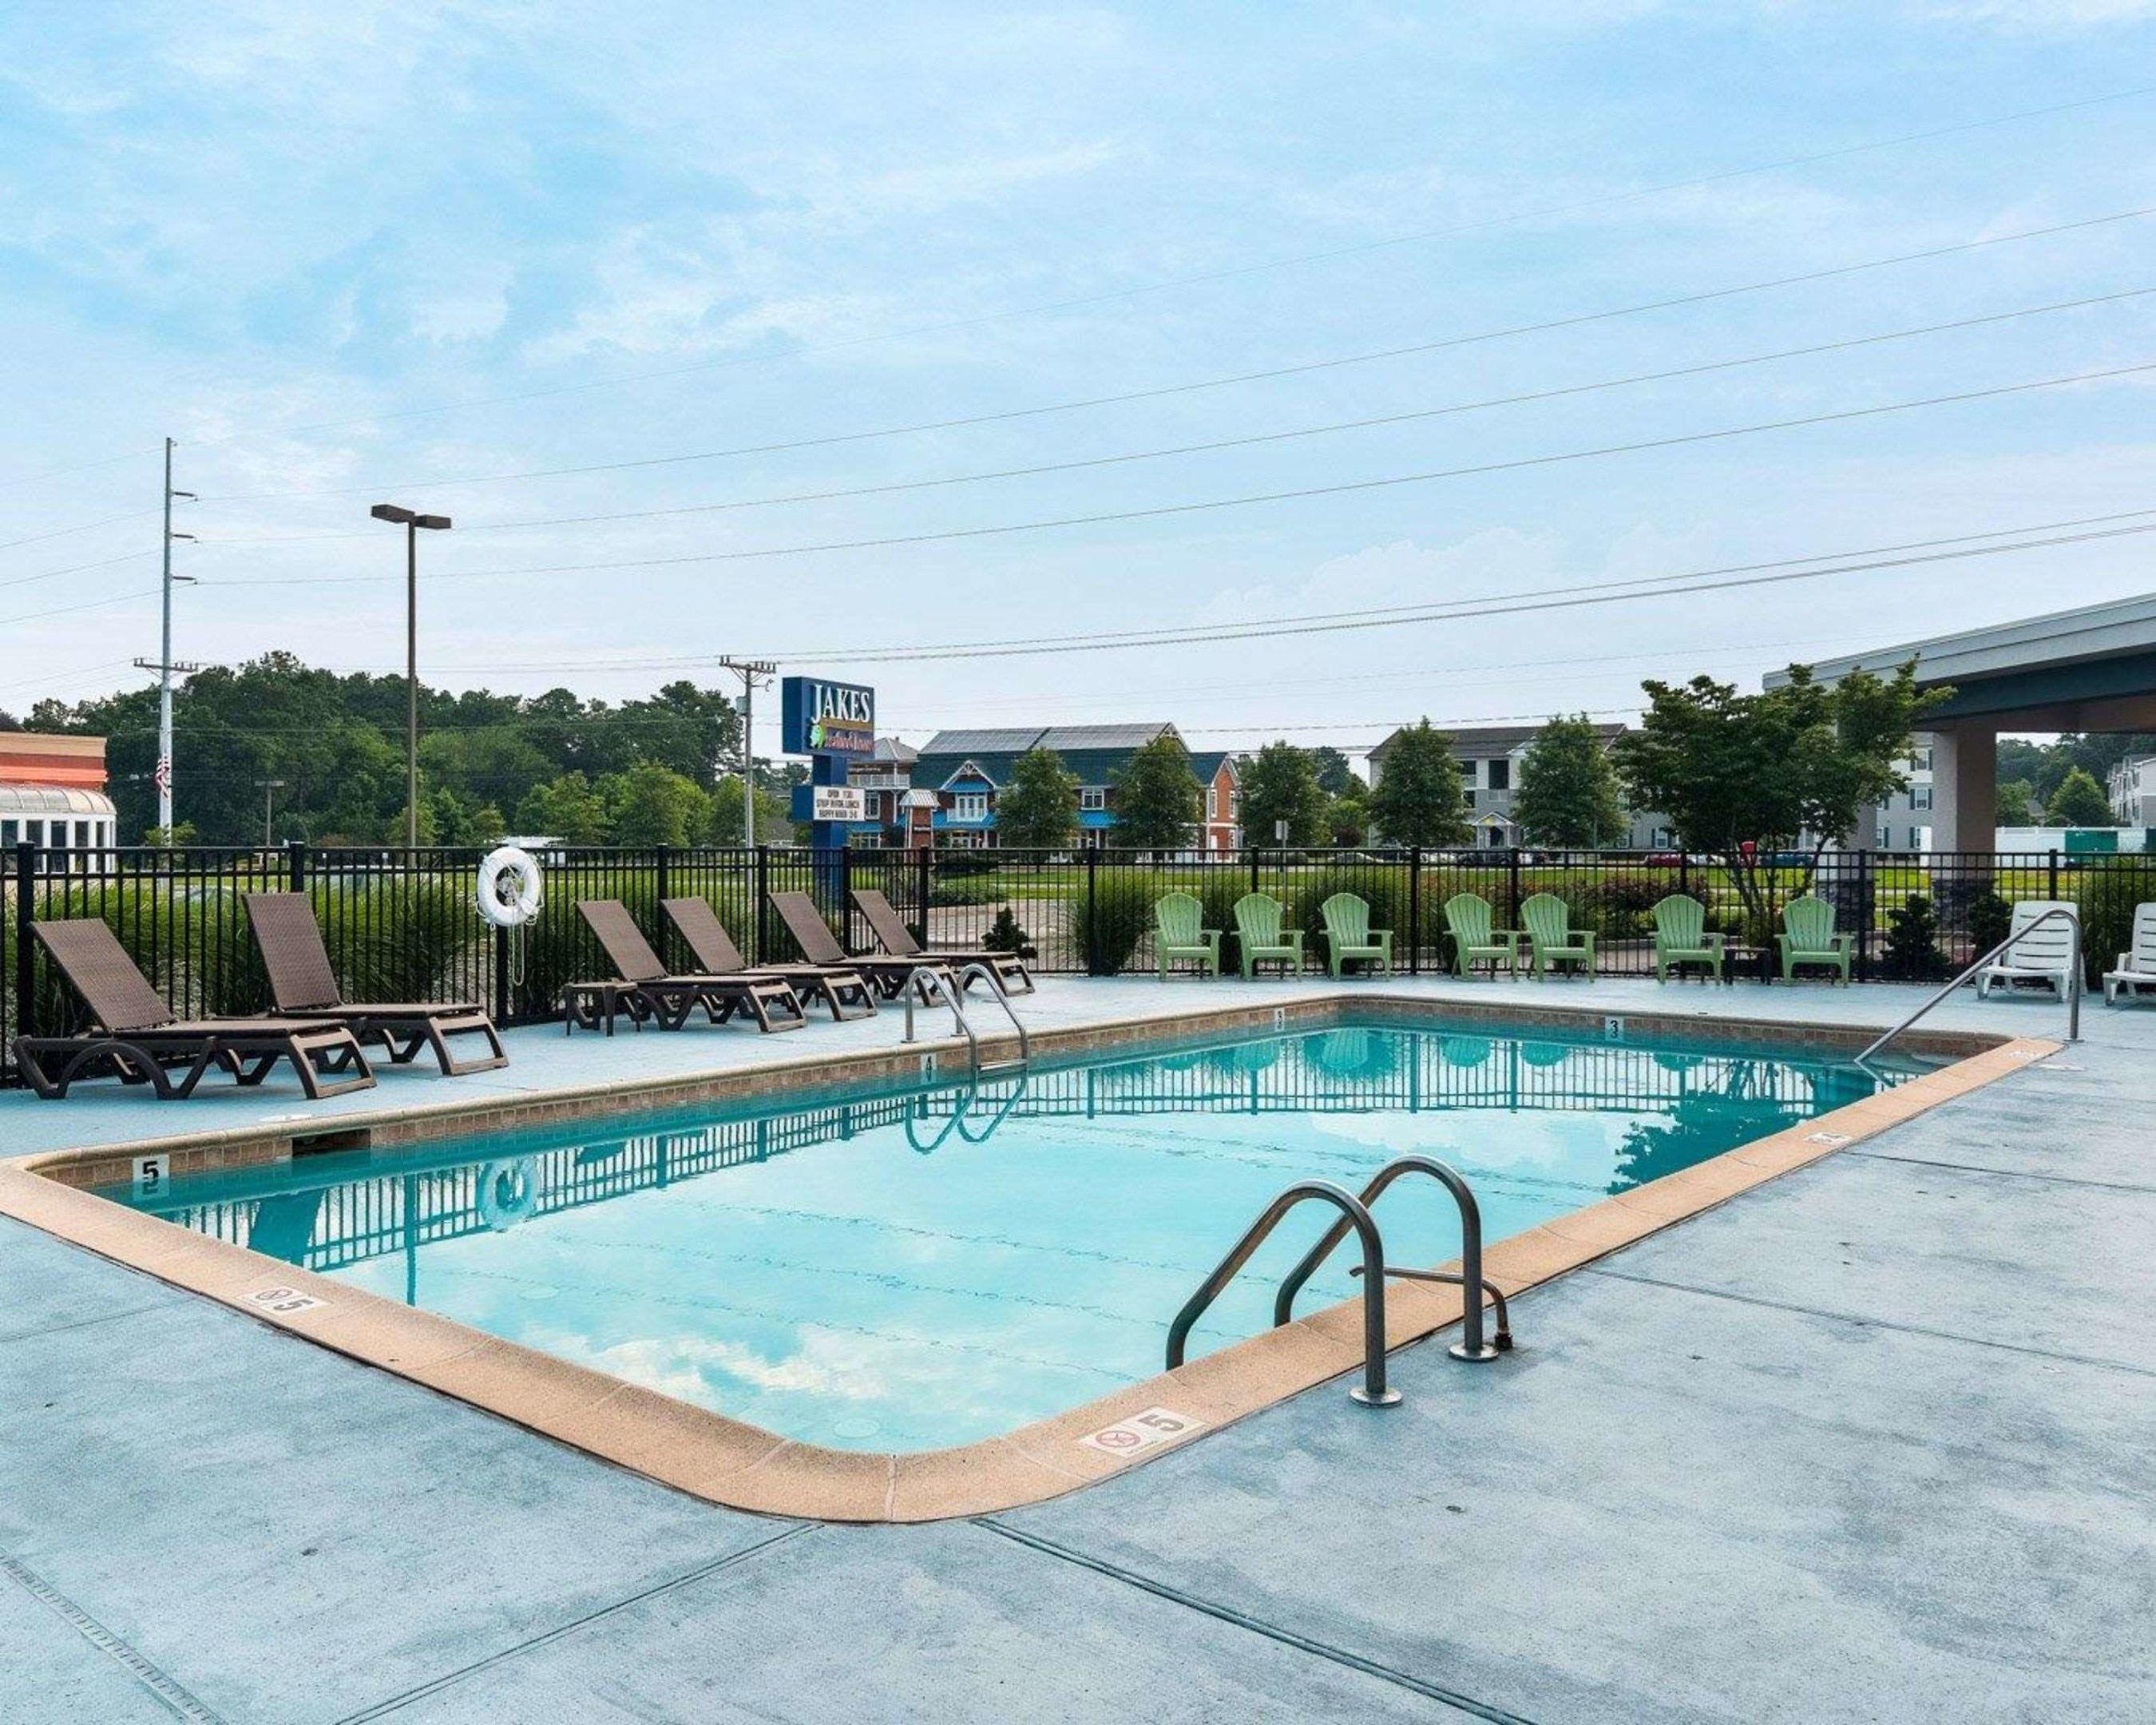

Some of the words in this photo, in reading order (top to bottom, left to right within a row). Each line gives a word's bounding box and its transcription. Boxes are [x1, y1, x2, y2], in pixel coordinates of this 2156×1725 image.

[810, 683, 870, 724] JAKES
[142, 1160, 159, 1183] 5
[273, 1299, 314, 1311] 5
[1137, 1413, 1185, 1432] 5
